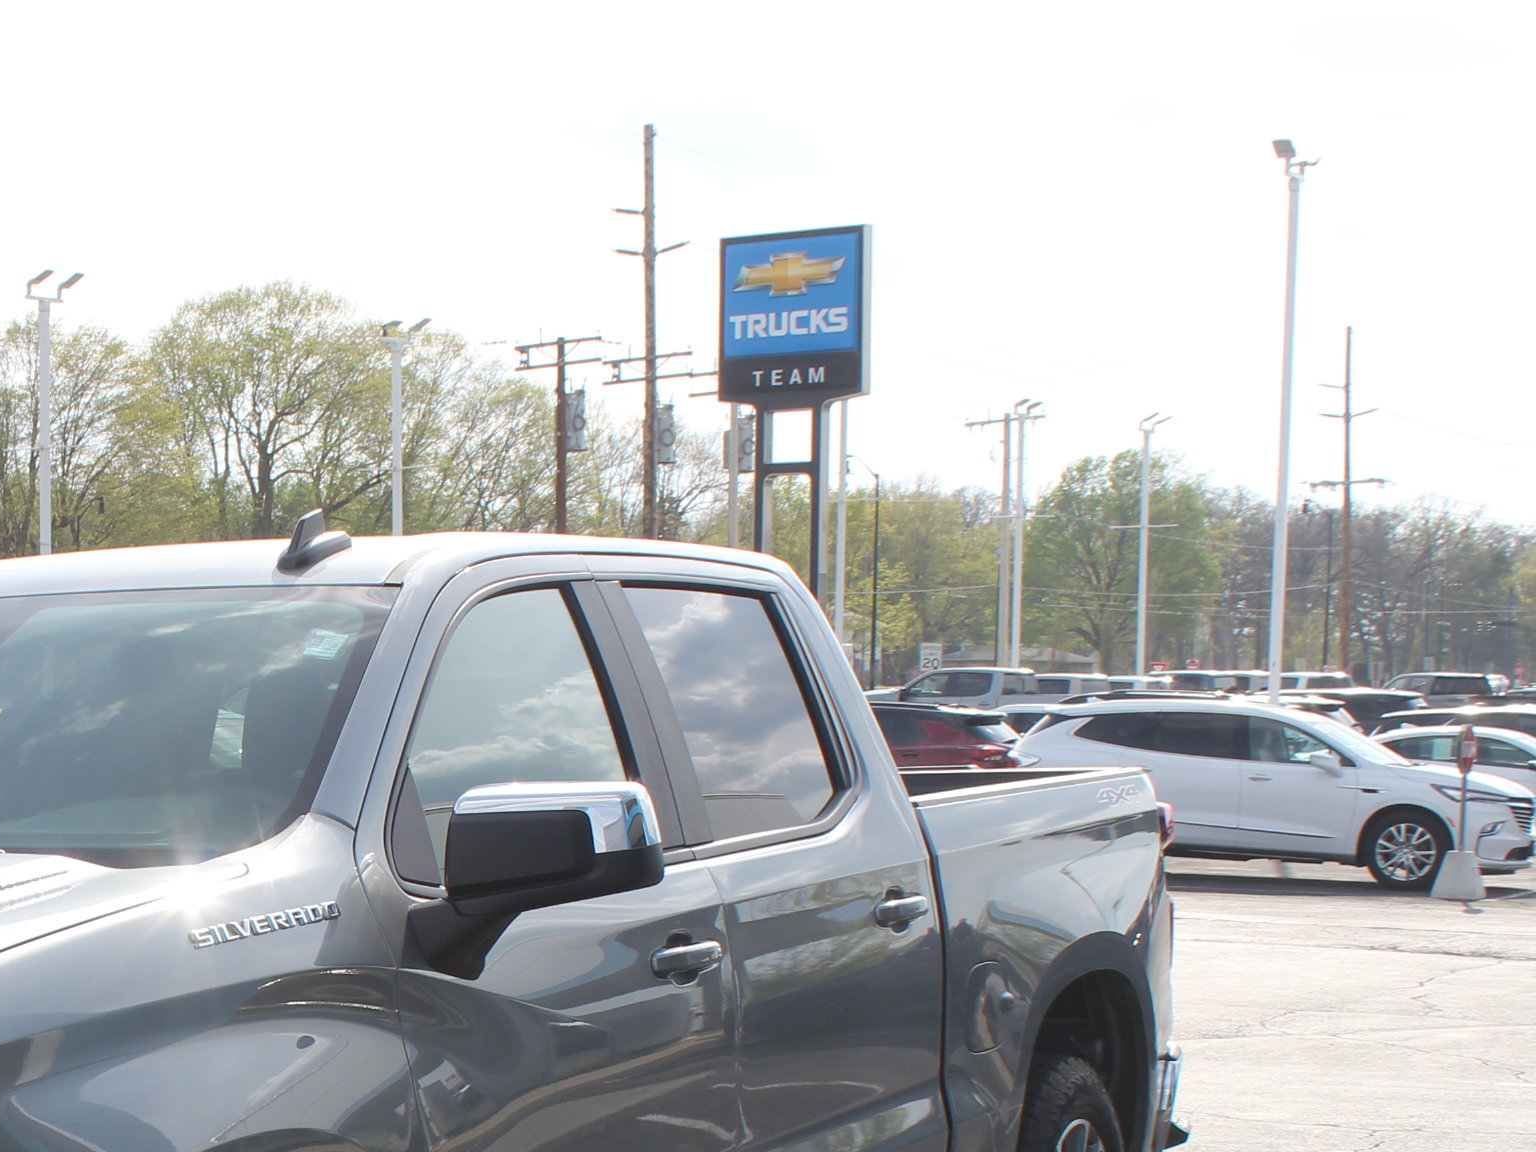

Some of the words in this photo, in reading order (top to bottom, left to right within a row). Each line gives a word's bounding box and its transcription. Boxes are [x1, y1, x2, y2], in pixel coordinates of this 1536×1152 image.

[729, 306, 849, 340] TRUCKS
[752, 366, 826, 387] TEAM
[922, 657, 940, 669] 20
[189, 900, 341, 949] SILVERADO
